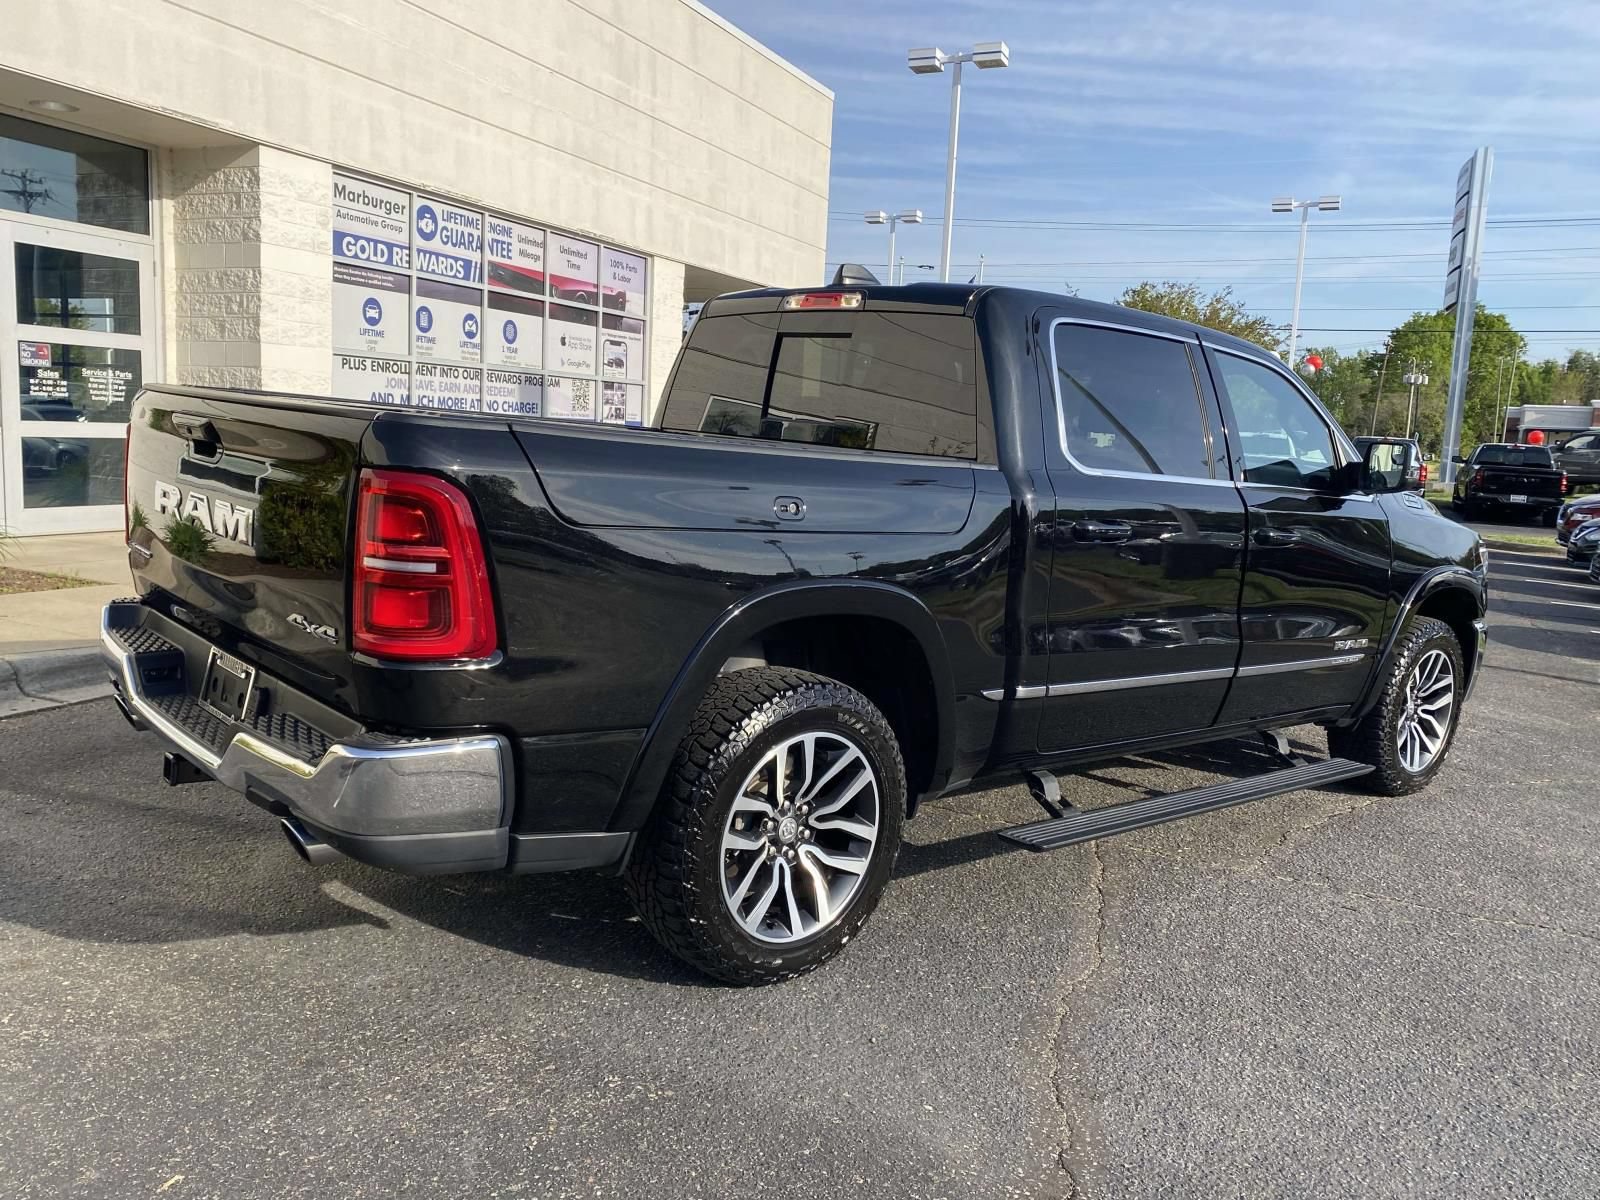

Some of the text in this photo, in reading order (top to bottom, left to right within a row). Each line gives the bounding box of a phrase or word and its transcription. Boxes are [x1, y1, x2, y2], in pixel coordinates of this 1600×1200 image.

[334, 182, 406, 215] Marburger
[336, 209, 403, 234] Automotive Group
[442, 209, 480, 230] LIFETIME
[517, 233, 543, 249] Unlimited
[342, 236, 464, 278] GOLD REWARDS
[519, 248, 540, 262] Mileage
[560, 245, 587, 260] Unlimited
[567, 260, 581, 270] Time
[610, 259, 638, 273] 100% Parts
[618, 273, 632, 283] Labor
[360, 327, 385, 338] LIFETIME
[416, 335, 436, 344] IFETIME
[460, 340, 480, 350] LIFETIME
[506, 346, 518, 354] YEAR
[568, 341, 592, 351] App Store
[37, 368, 60, 379] Sales
[81, 367, 107, 377] Service
[115, 370, 132, 379] Parts
[342, 358, 367, 371] PLUS
[440, 366, 459, 379] INTO
[462, 369, 480, 381] OUR
[439, 380, 460, 393] EARN
[463, 382, 480, 394] AND
[371, 392, 394, 404] AND
[438, 396, 467, 409] MORE!
[469, 399, 480, 411] AT
[502, 401, 538, 414] CHARGE!
[155, 480, 254, 547] RAM
